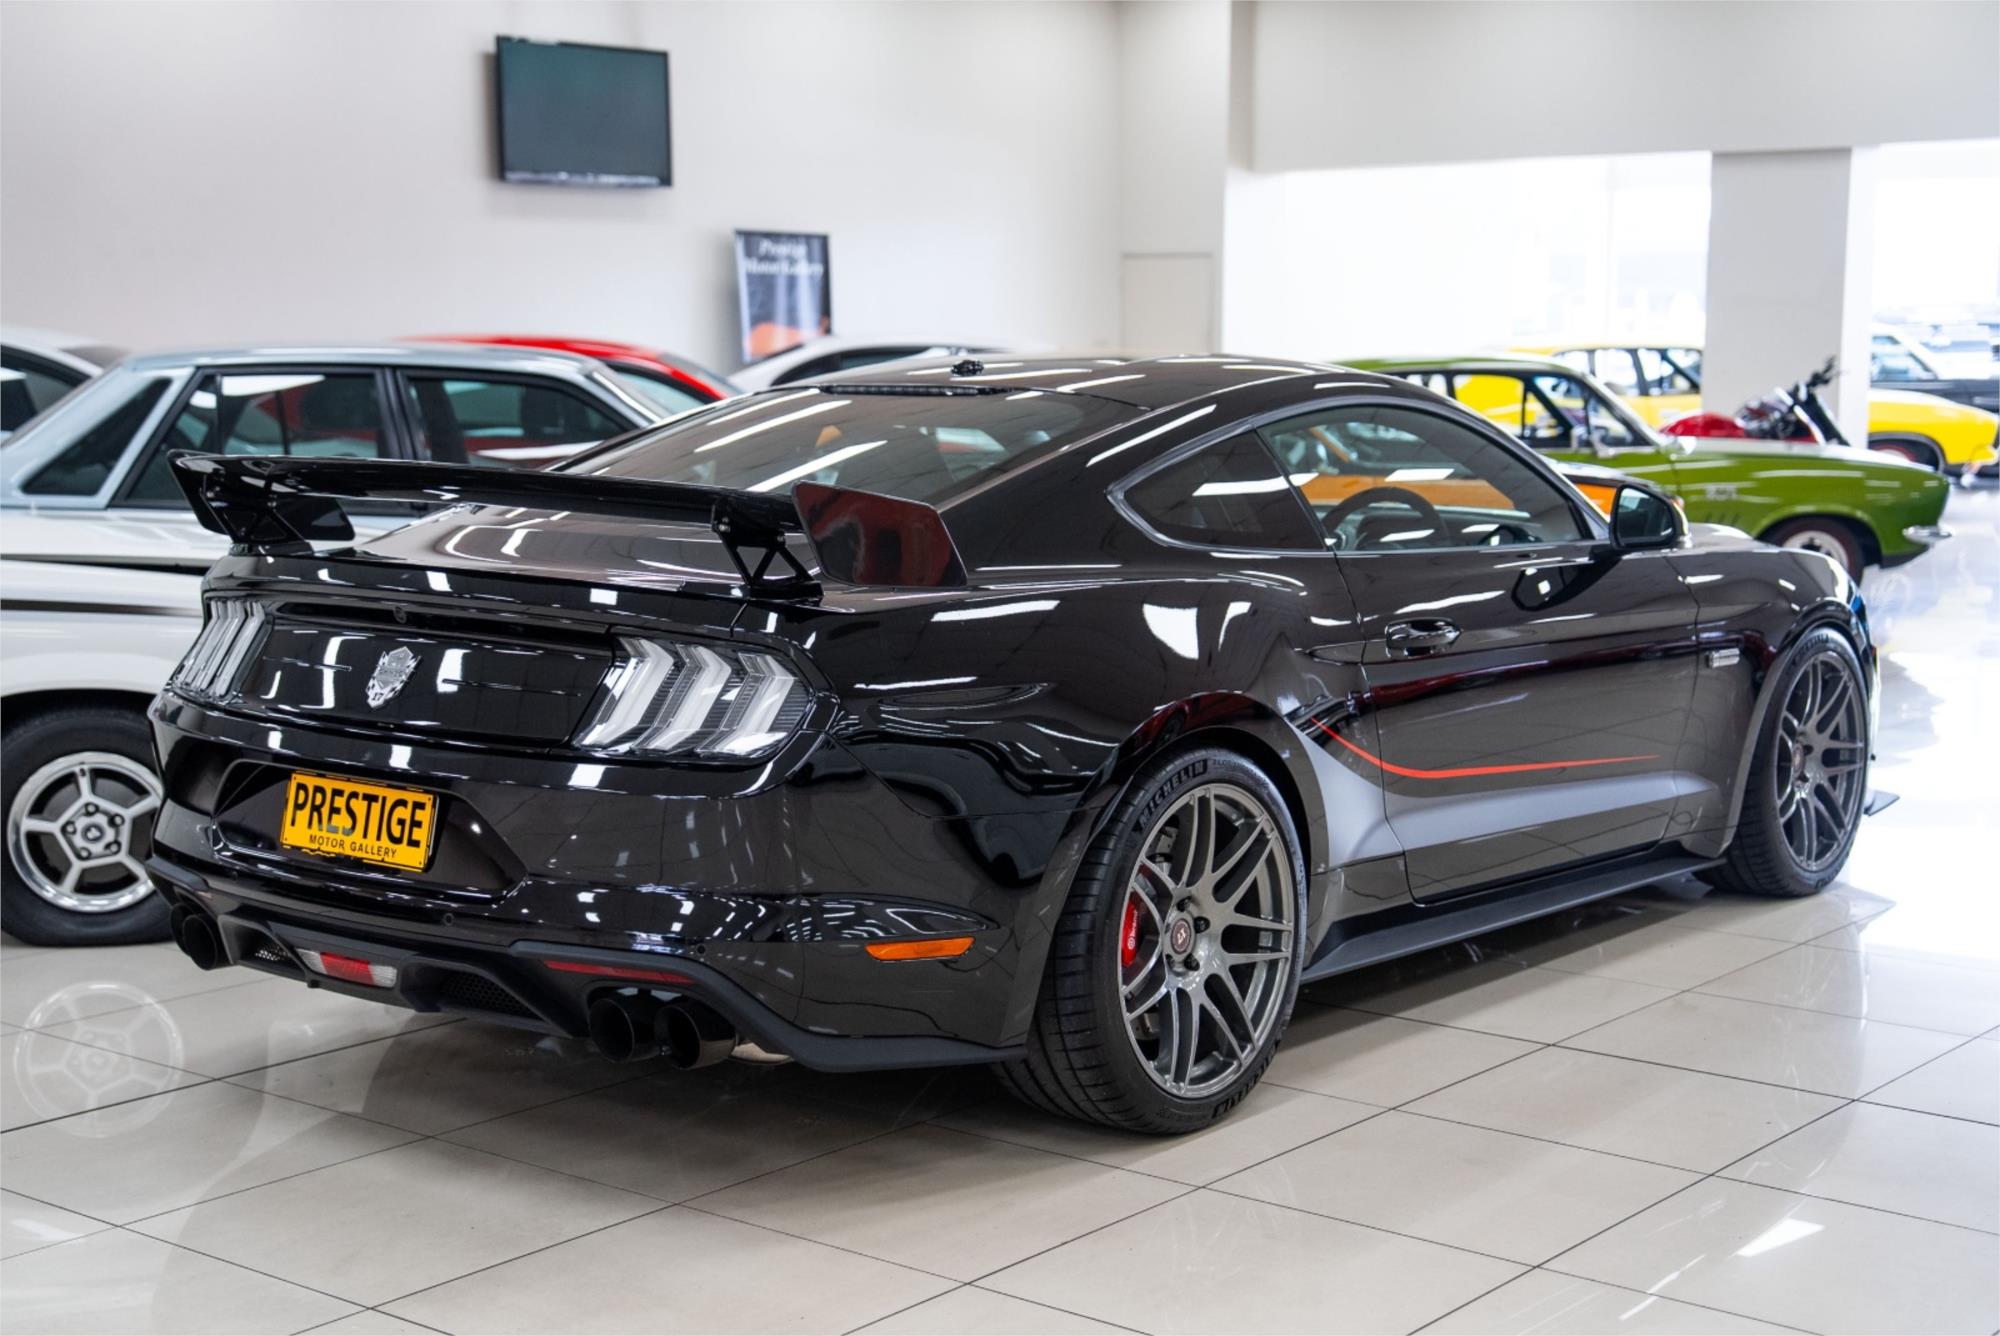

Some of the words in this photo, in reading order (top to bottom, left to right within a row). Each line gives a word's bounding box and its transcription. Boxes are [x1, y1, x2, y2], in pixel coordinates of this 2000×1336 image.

[290, 781, 426, 849] PRESTIGE
[1136, 758, 1208, 830] MICHELIN
[308, 834, 346, 850] MOTOR
[349, 841, 398, 859] GALLERY
